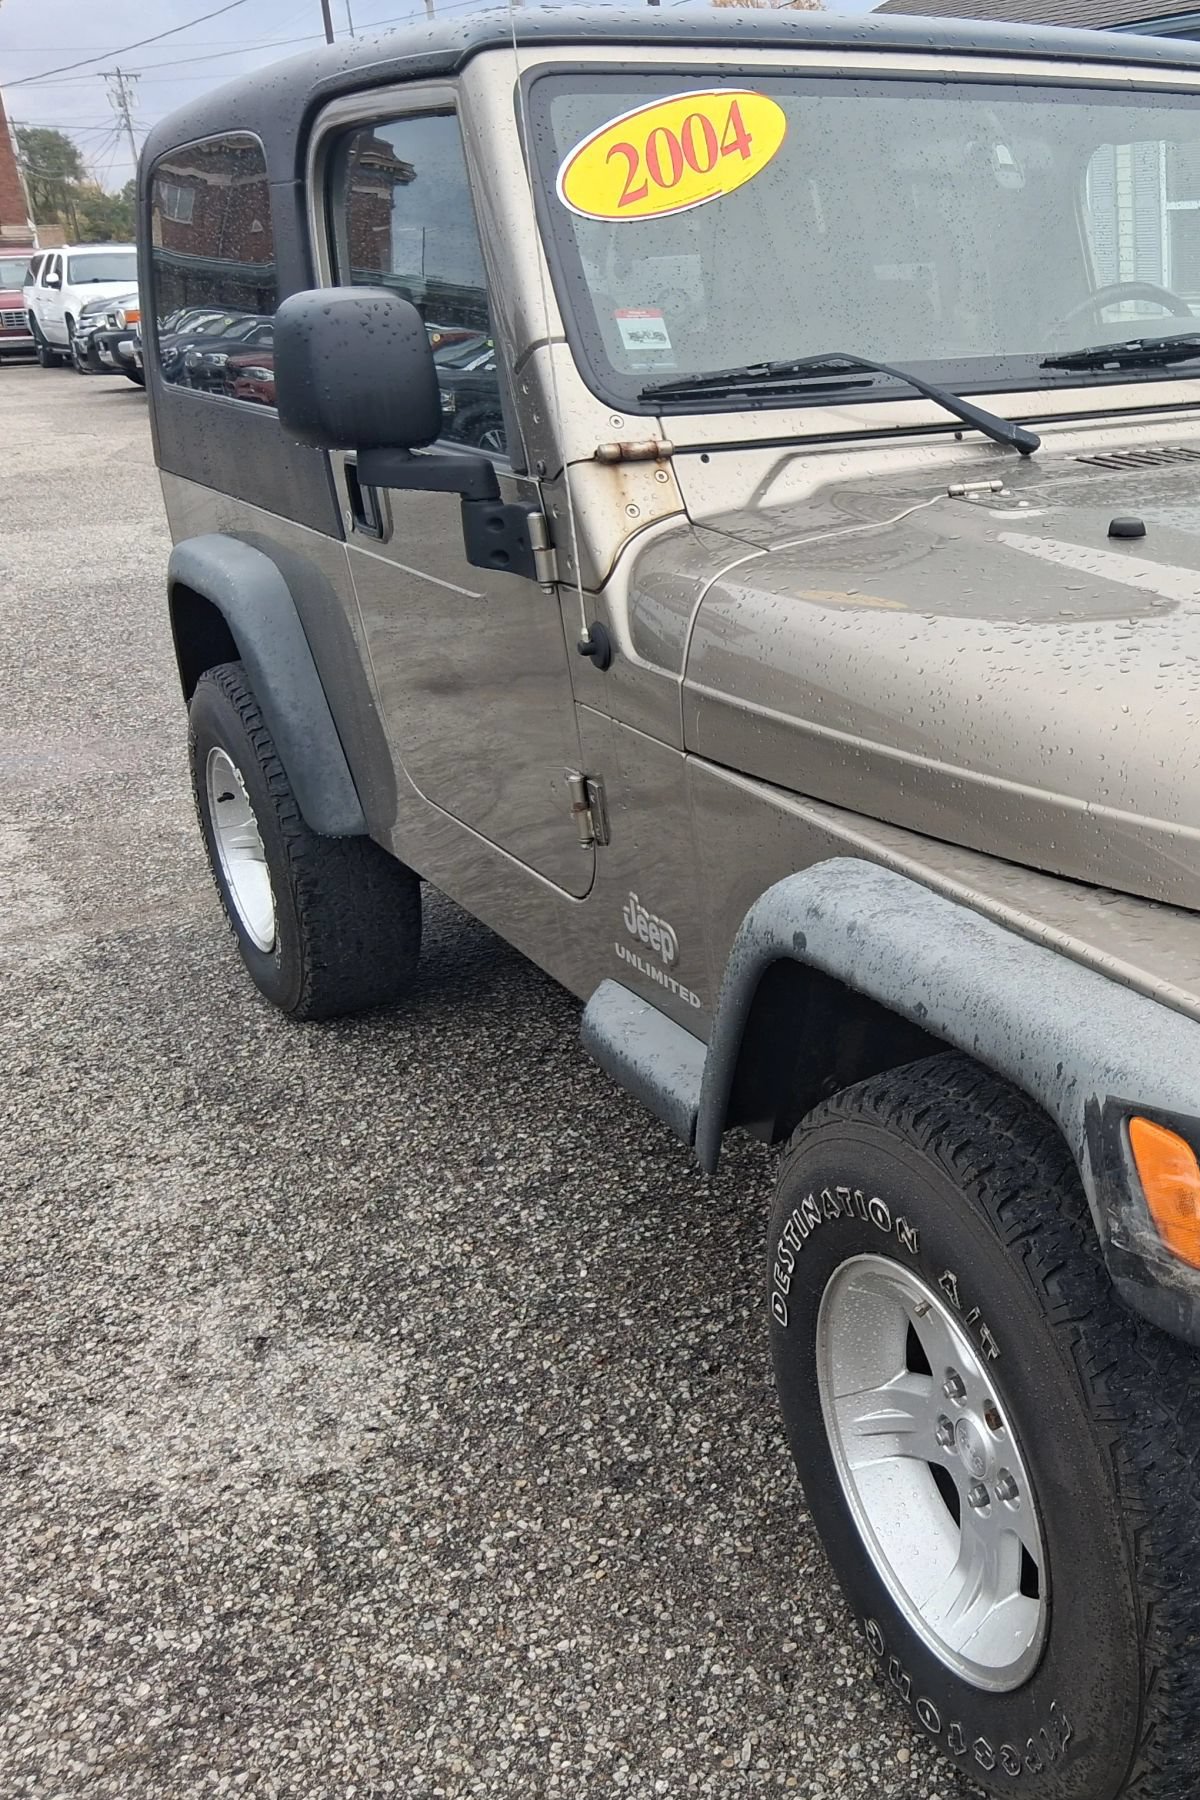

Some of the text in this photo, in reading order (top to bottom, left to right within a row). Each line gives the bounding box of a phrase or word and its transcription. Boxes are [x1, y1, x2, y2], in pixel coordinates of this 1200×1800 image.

[606, 100, 753, 208] 2004
[623, 891, 679, 964] Jeep
[615, 942, 701, 1008] UNLIMITED
[771, 1186, 920, 1327] DESTINATION
